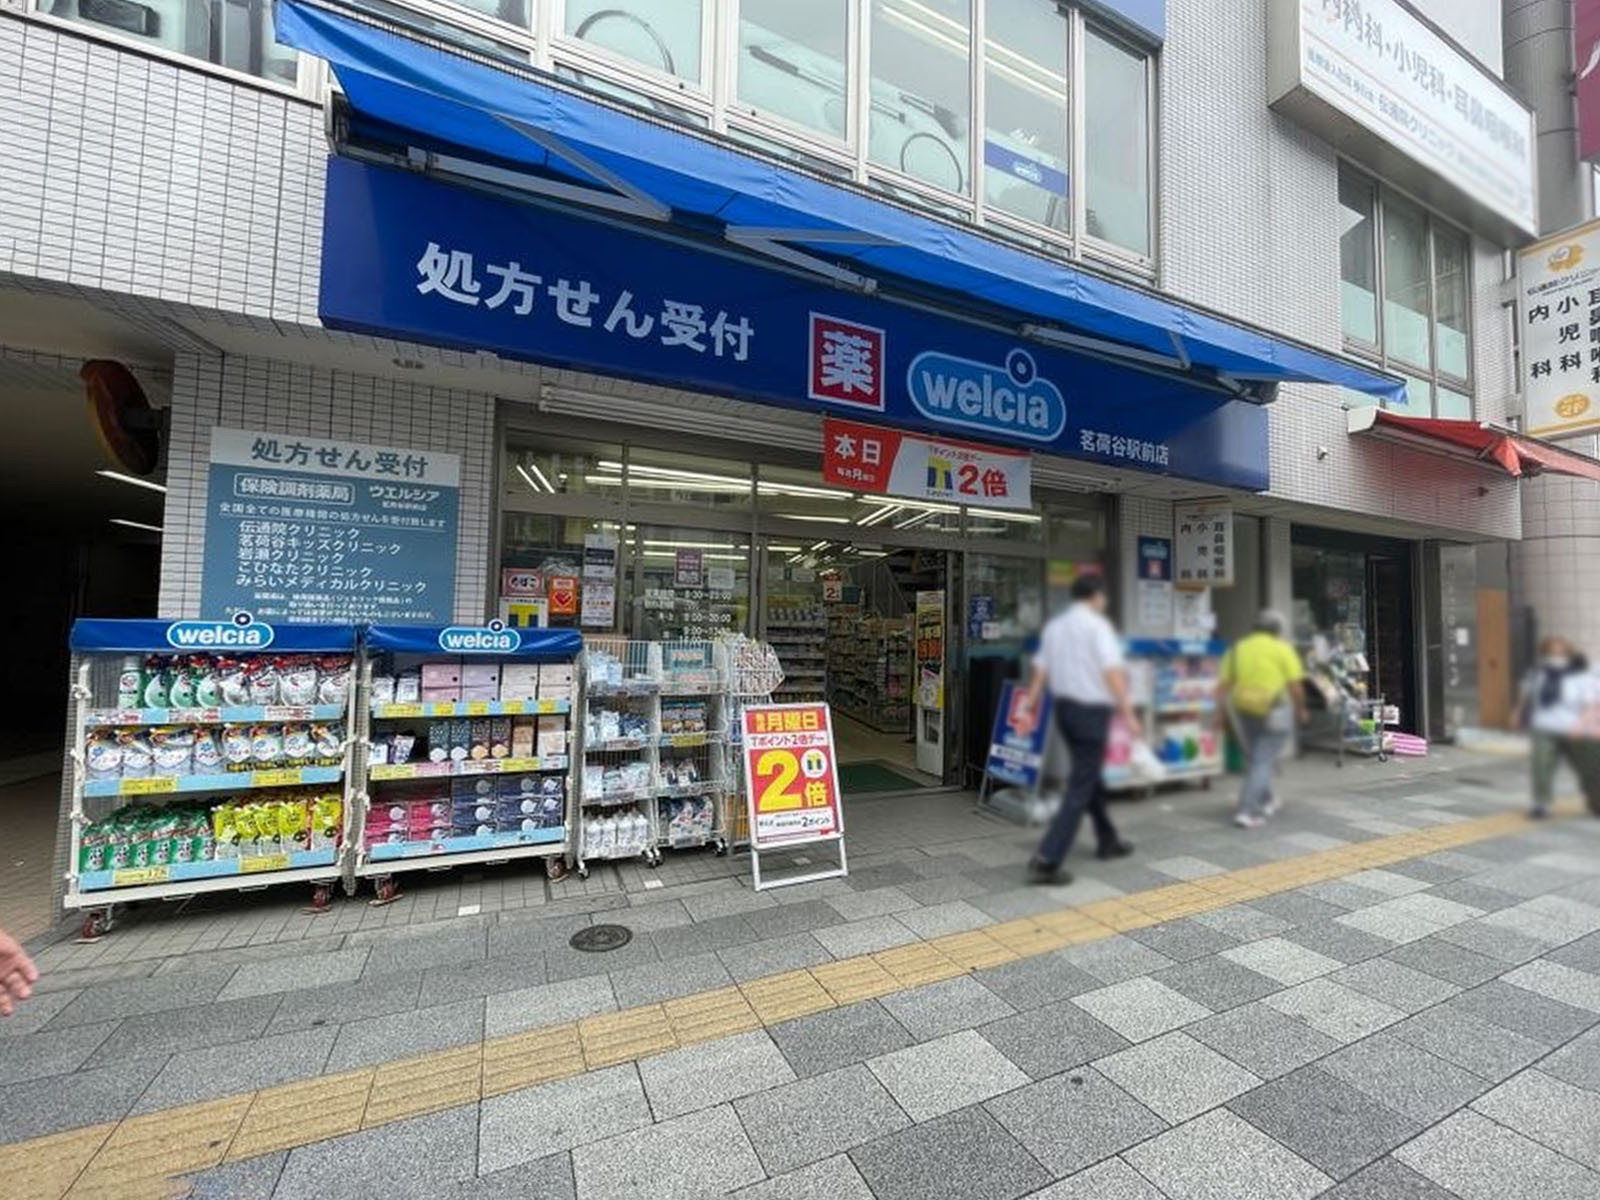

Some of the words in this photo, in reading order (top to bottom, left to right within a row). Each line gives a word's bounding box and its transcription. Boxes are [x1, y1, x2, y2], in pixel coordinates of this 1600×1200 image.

[416, 241, 755, 362] 処方せん受付
[1557, 295, 1582, 373] 小児科
[820, 330, 875, 397] 薬
[922, 362, 1049, 430] welcia
[251, 437, 429, 479] 処方せん受付
[834, 433, 882, 466] 本日
[1079, 429, 1170, 466] 茗荷谷駅前店
[240, 477, 350, 502] 保険調剤薬局
[957, 463, 1008, 498] 2倍
[239, 520, 361, 539] 伝通院クリニック
[235, 574, 428, 594] みらいメディカルクリニック
[177, 622, 262, 646] welcia
[447, 628, 511, 649] welcia
[757, 748, 803, 812] 2
[804, 781, 828, 807] 倍
